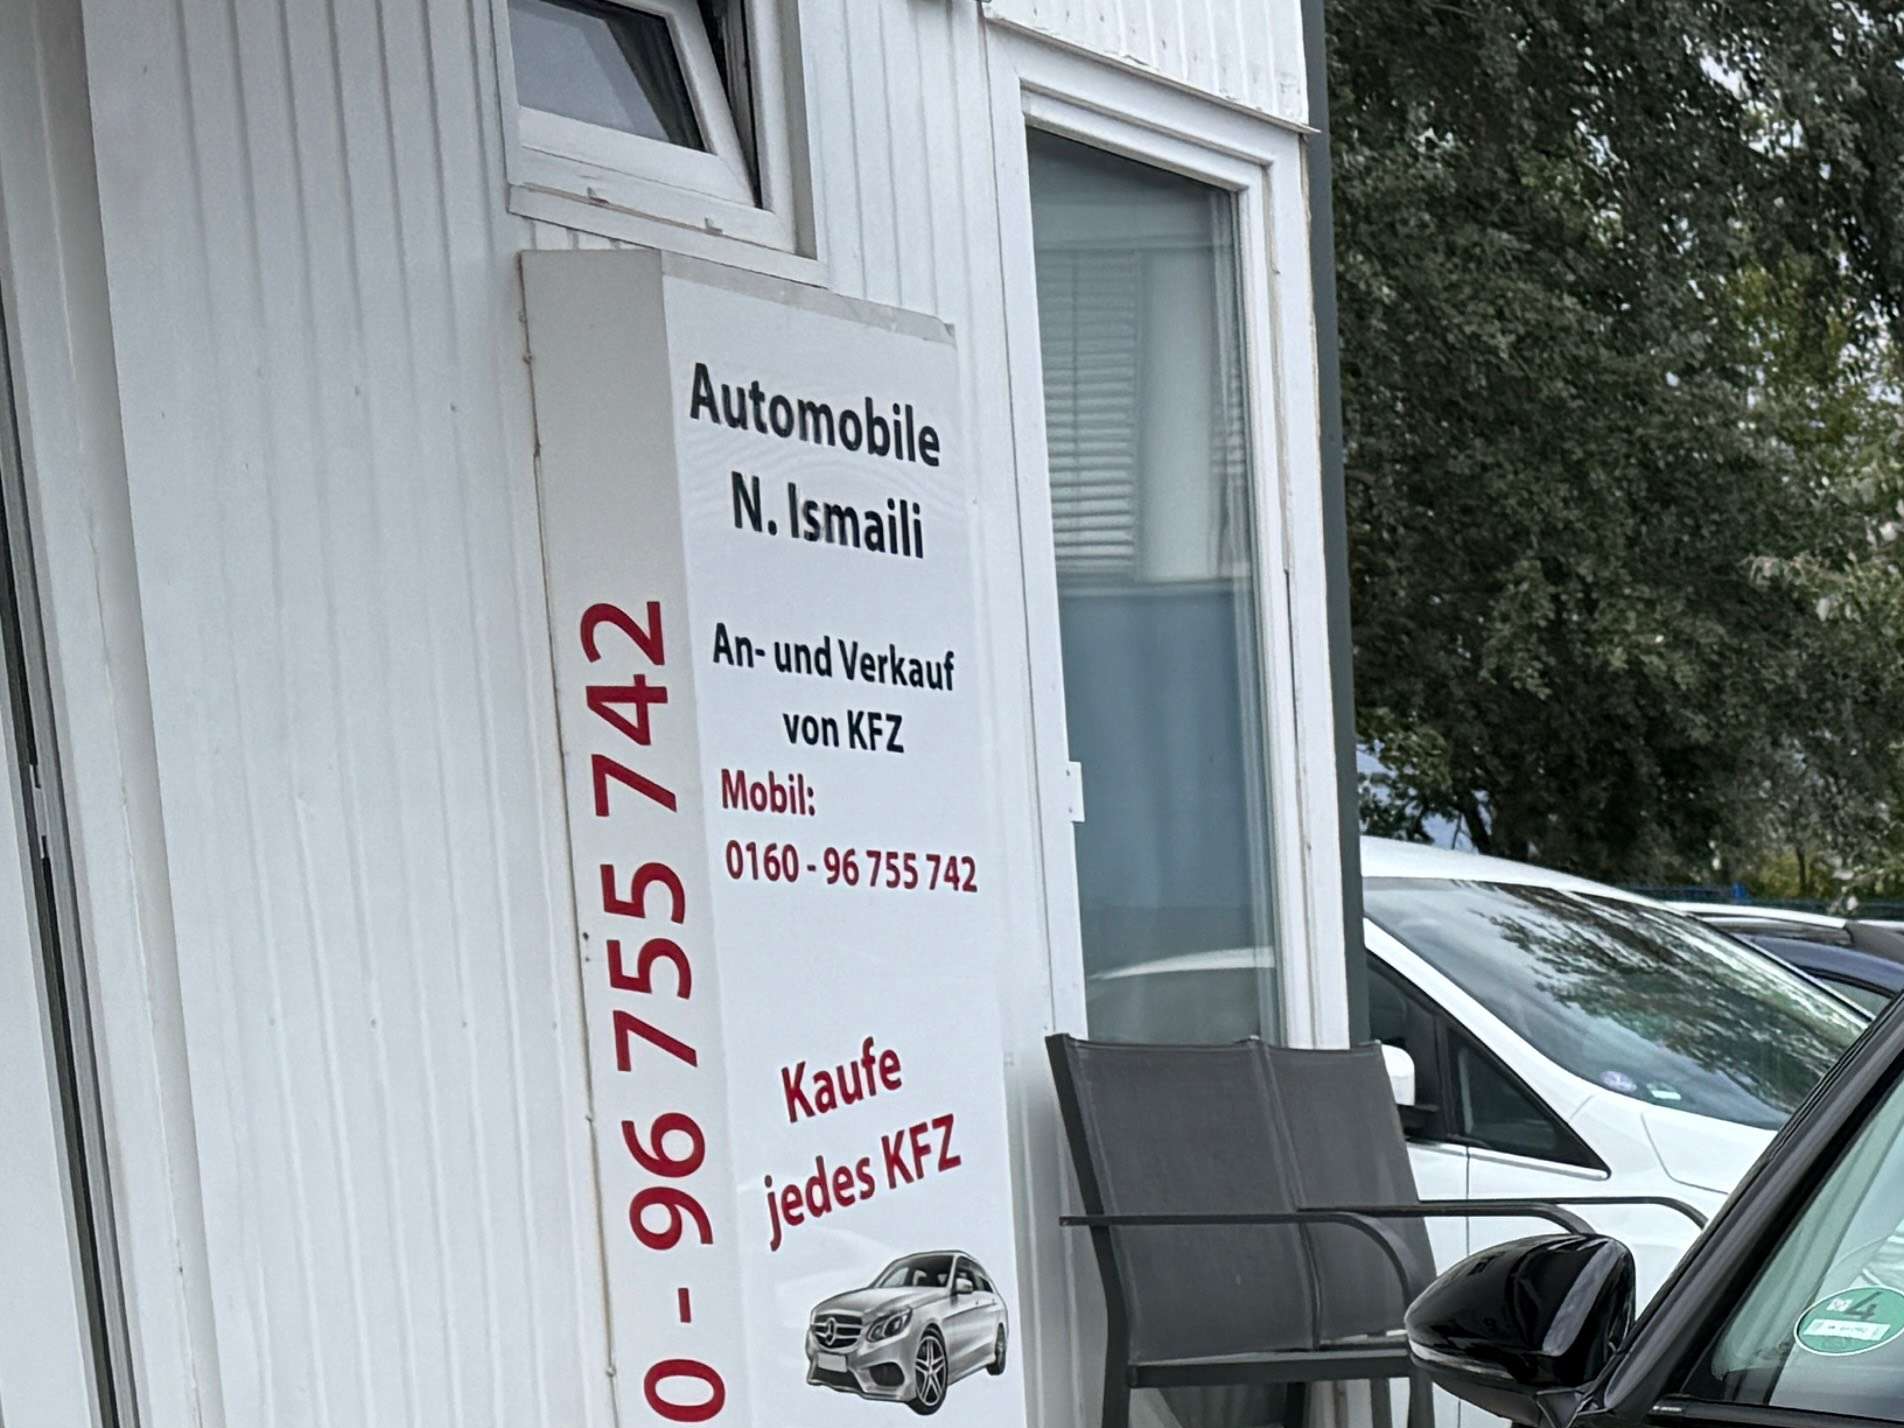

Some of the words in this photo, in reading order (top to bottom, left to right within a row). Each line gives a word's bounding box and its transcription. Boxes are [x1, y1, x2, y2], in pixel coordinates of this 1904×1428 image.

[689, 362, 941, 467] Automobile
[731, 470, 779, 537] N.
[787, 482, 925, 559] Ismaili
[712, 622, 767, 669] An-
[773, 635, 834, 678] und
[837, 638, 956, 692] Verkauf
[580, 601, 676, 817] 742
[782, 713, 841, 748] von
[846, 709, 906, 754] KFZ
[721, 768, 817, 817] Mobil:
[725, 839, 800, 883] 0160
[823, 846, 861, 887] 96
[865, 849, 920, 890] 755
[925, 853, 979, 894] 742
[600, 861, 697, 1071] 755
[781, 1036, 903, 1124] Kaufe
[621, 1111, 712, 1250] 96
[764, 1155, 877, 1252] jedes
[881, 1113, 963, 1190] KFZ
[1842, 1290, 1885, 1321] 4
